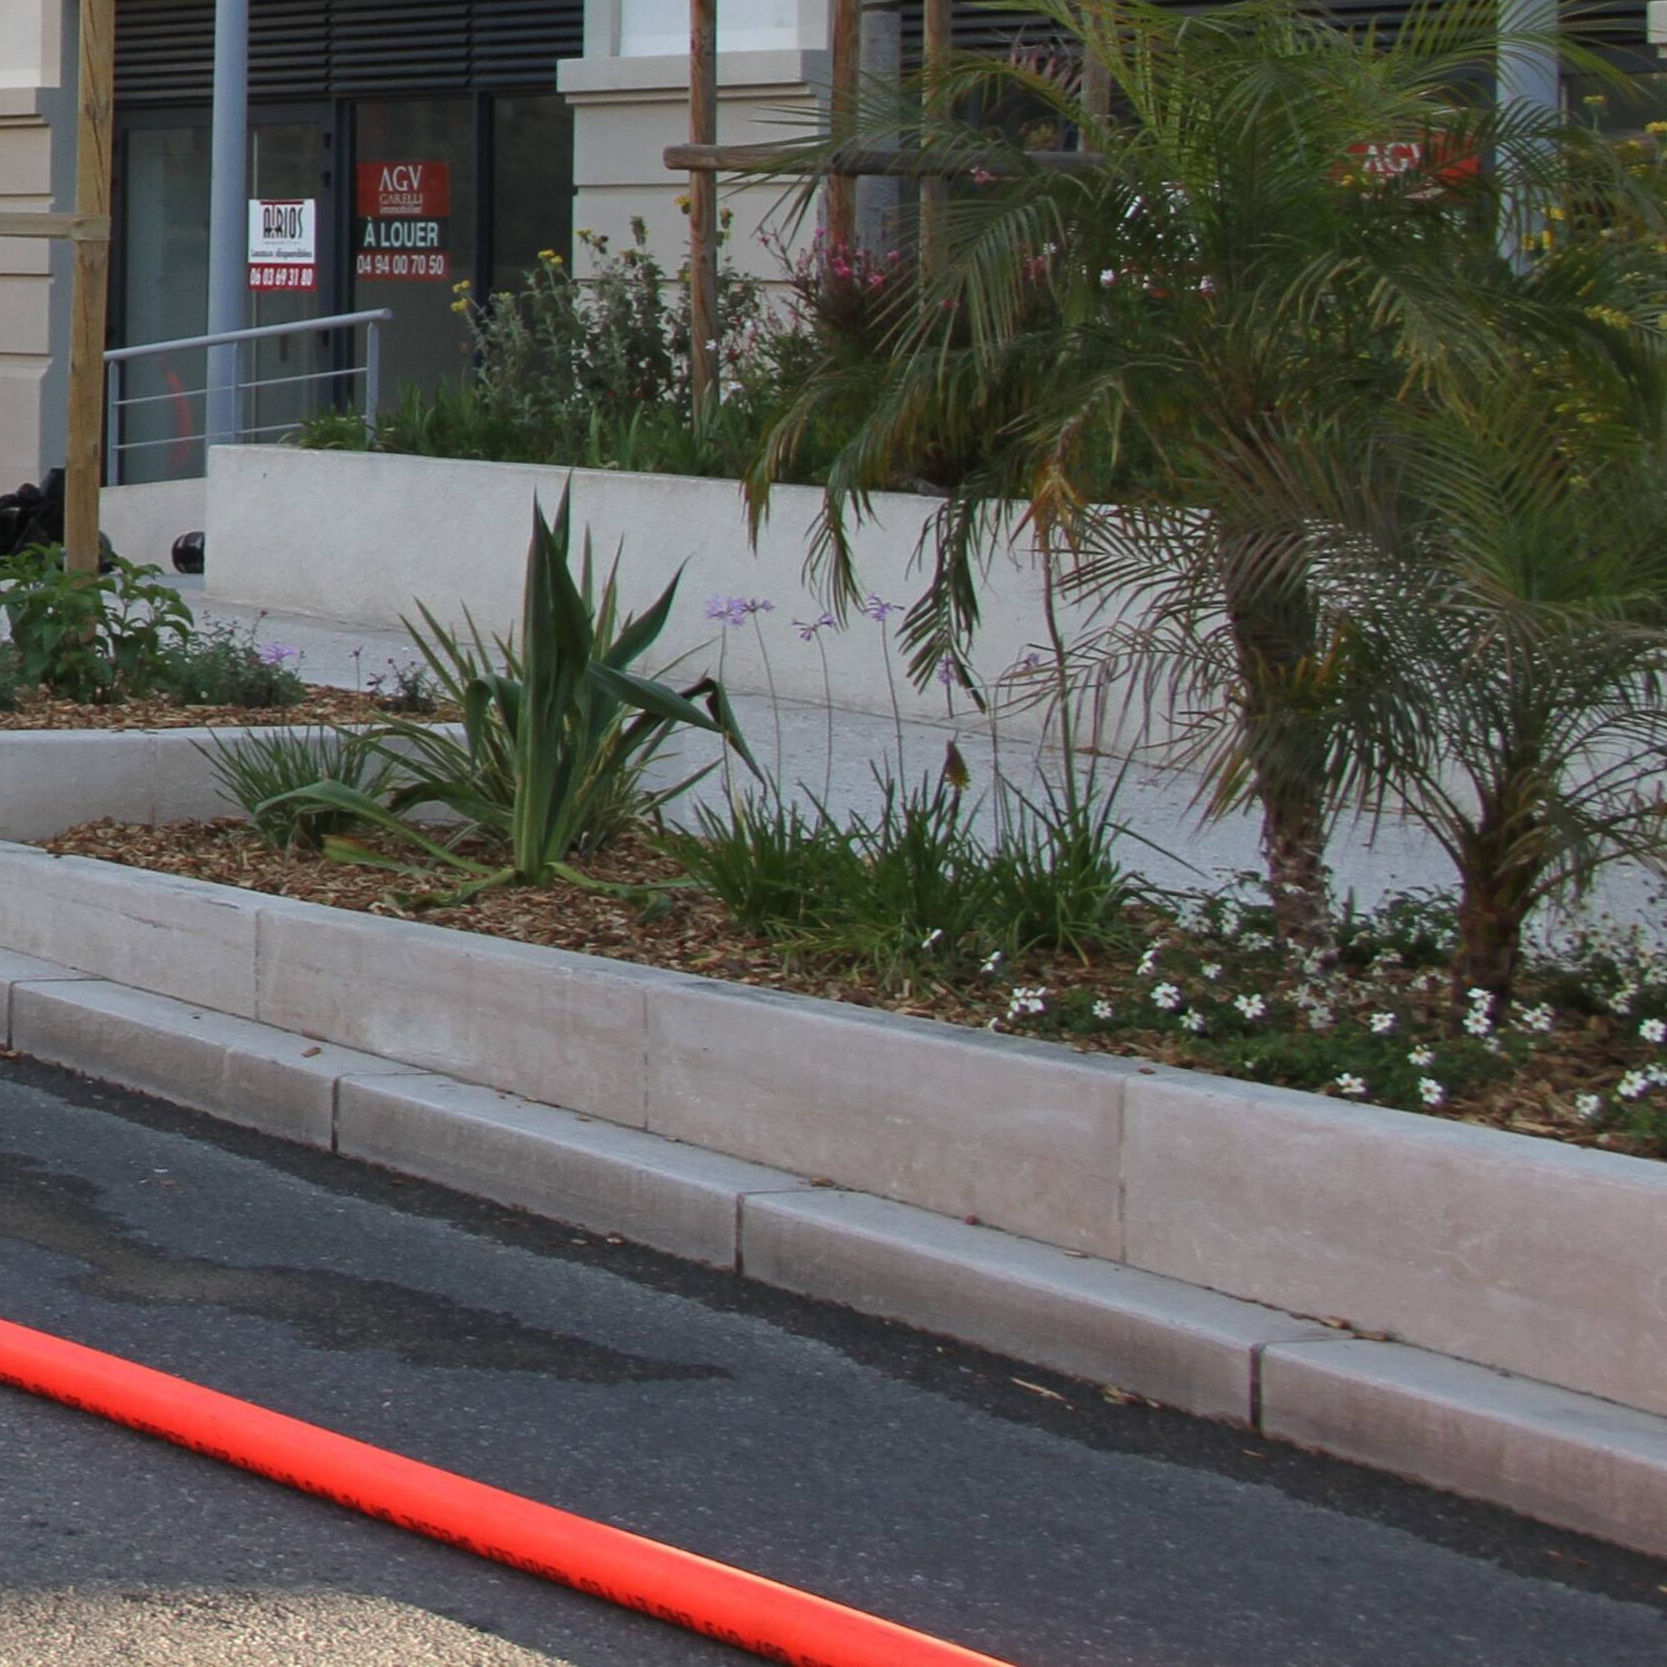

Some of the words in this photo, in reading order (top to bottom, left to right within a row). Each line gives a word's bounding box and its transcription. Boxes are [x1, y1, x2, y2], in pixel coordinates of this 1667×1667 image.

[378, 165, 423, 191] AGV
[378, 193, 423, 205] GARELLI
[363, 216, 376, 247] À
[380, 221, 439, 247] LOUER
[356, 255, 372, 274] 04
[375, 255, 389, 274] 94
[393, 255, 407, 274] 00
[411, 255, 426, 274] 70
[429, 255, 444, 274] 50
